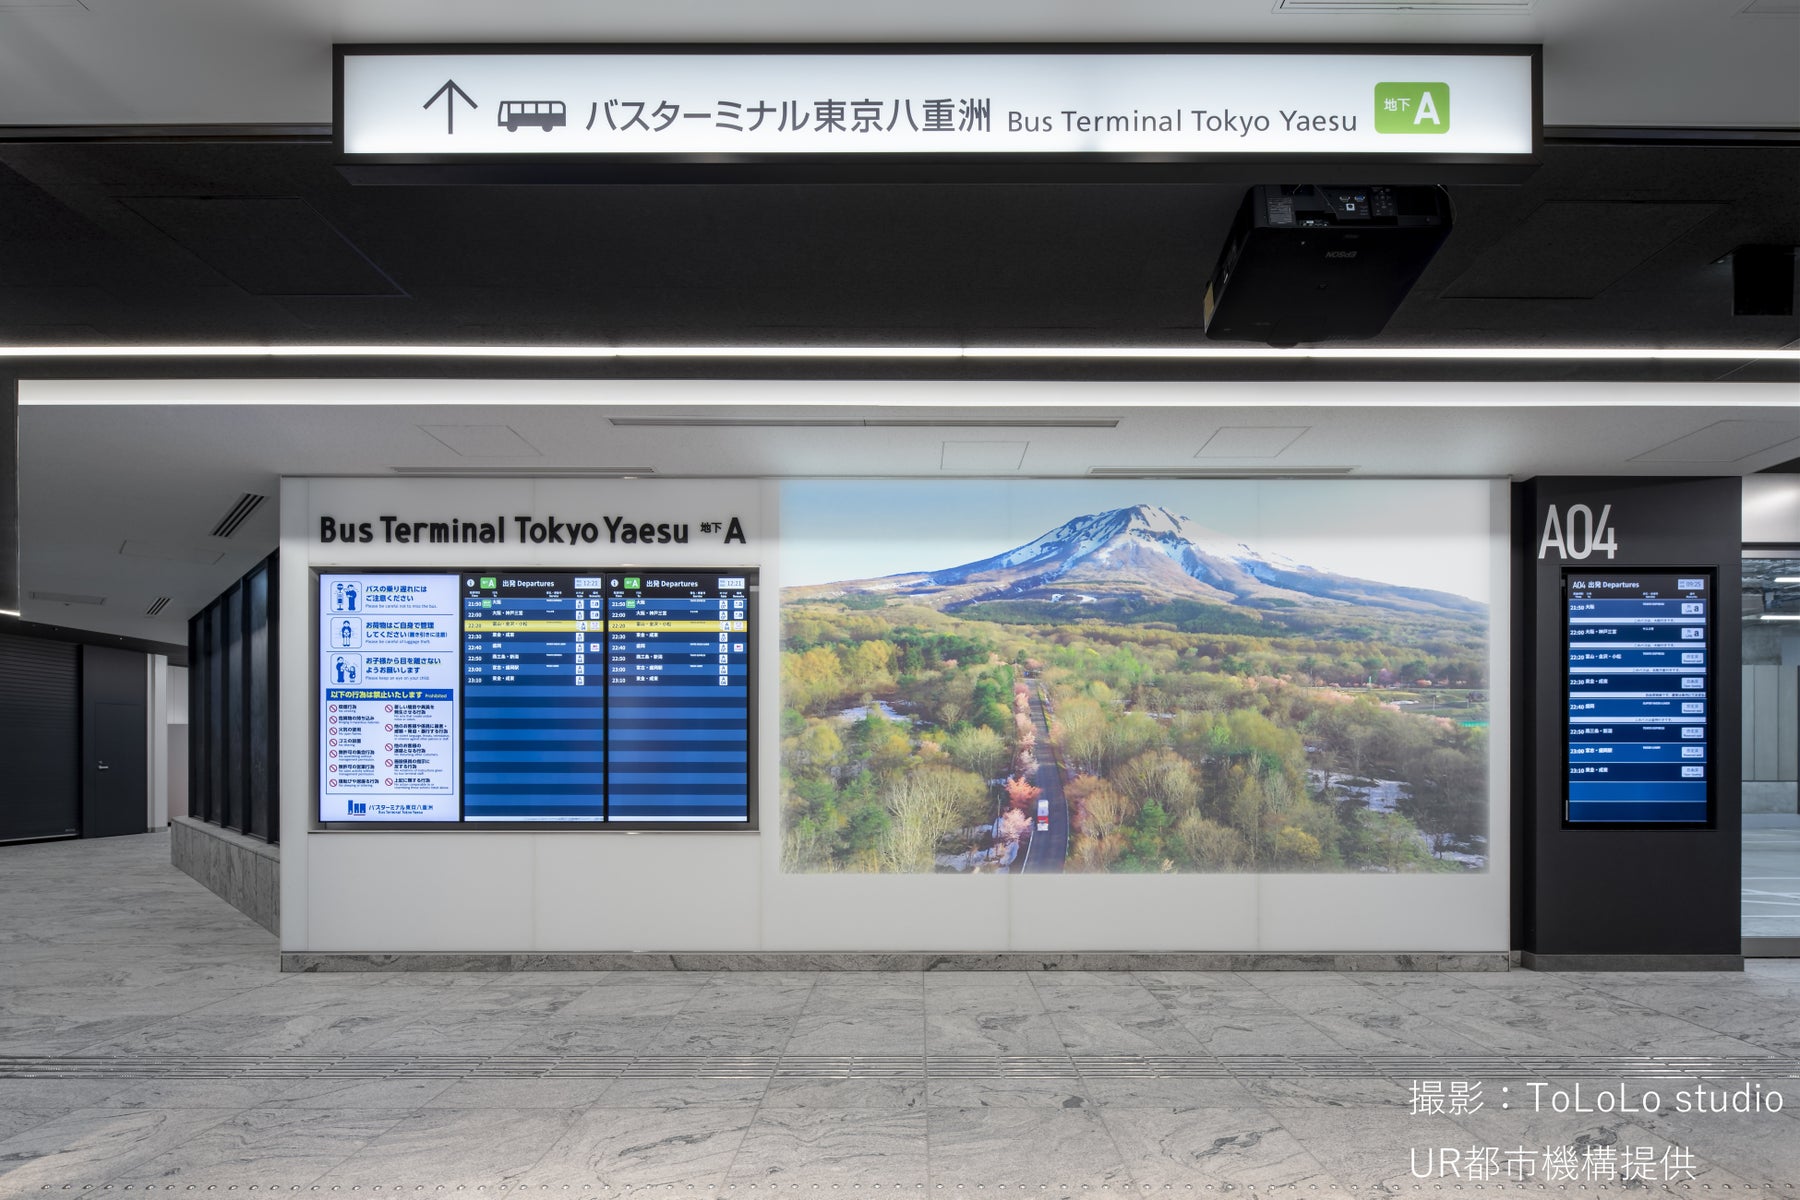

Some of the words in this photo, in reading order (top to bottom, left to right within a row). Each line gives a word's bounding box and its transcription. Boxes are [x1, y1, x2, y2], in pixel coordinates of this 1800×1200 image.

[585, 98, 991, 133] バスターミナル東京八重洲
[1008, 111, 1053, 132] Bus
[1061, 109, 1182, 132] Terminal
[1191, 109, 1270, 137] Tokyo
[1280, 110, 1357, 132] Yaesu
[1384, 98, 1411, 112] 地下
[1413, 91, 1441, 125] A
[320, 517, 373, 543] Bus
[380, 516, 505, 543] Terminal
[515, 516, 599, 545] Tokyo
[603, 516, 689, 544] Yaesu
[700, 522, 722, 533] 地下
[724, 517, 746, 544] A
[1538, 504, 1618, 559] A04
[517, 580, 554, 588] Departures
[661, 580, 698, 588] Departures
